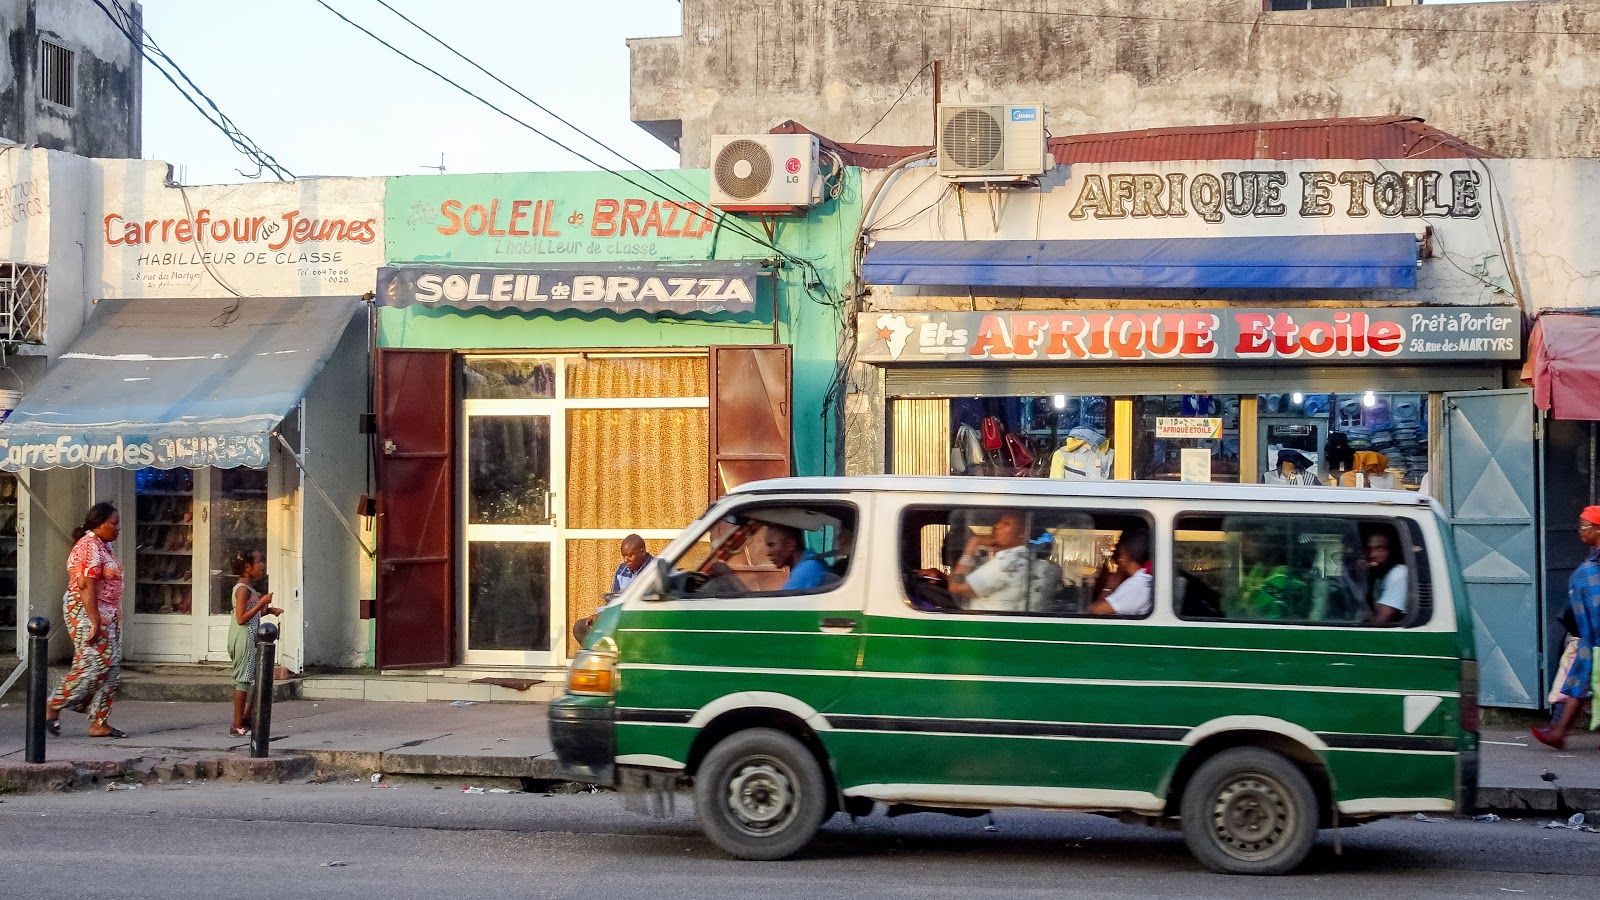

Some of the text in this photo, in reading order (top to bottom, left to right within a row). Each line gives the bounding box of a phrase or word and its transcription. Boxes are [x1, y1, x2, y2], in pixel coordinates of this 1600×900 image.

[786, 175, 799, 184] LG
[1069, 170, 1481, 222] AFRIQUE ETOILE
[104, 209, 266, 246] Carrefour
[437, 199, 561, 237] SOLEIL
[567, 209, 584, 229] de
[591, 198, 714, 239] BRAZZA
[261, 220, 280, 241] des
[268, 210, 376, 251] Jeunes
[587, 241, 601, 254] de
[137, 251, 343, 266] HABILLEUR DE CLASSE
[415, 273, 548, 302] SOLEIL
[551, 280, 571, 299] de
[571, 275, 754, 303] BRAZZA
[1411, 312, 1512, 332] Prêt à Porter
[969, 313, 1220, 360] AFRIQUE
[1234, 312, 1406, 358] Etoile
[1442, 339, 1458, 352] des
[1459, 337, 1513, 352] MARTYRS
[1163, 426, 1188, 435] AFRIQUE
[1190, 426, 1211, 435] ETOILE
